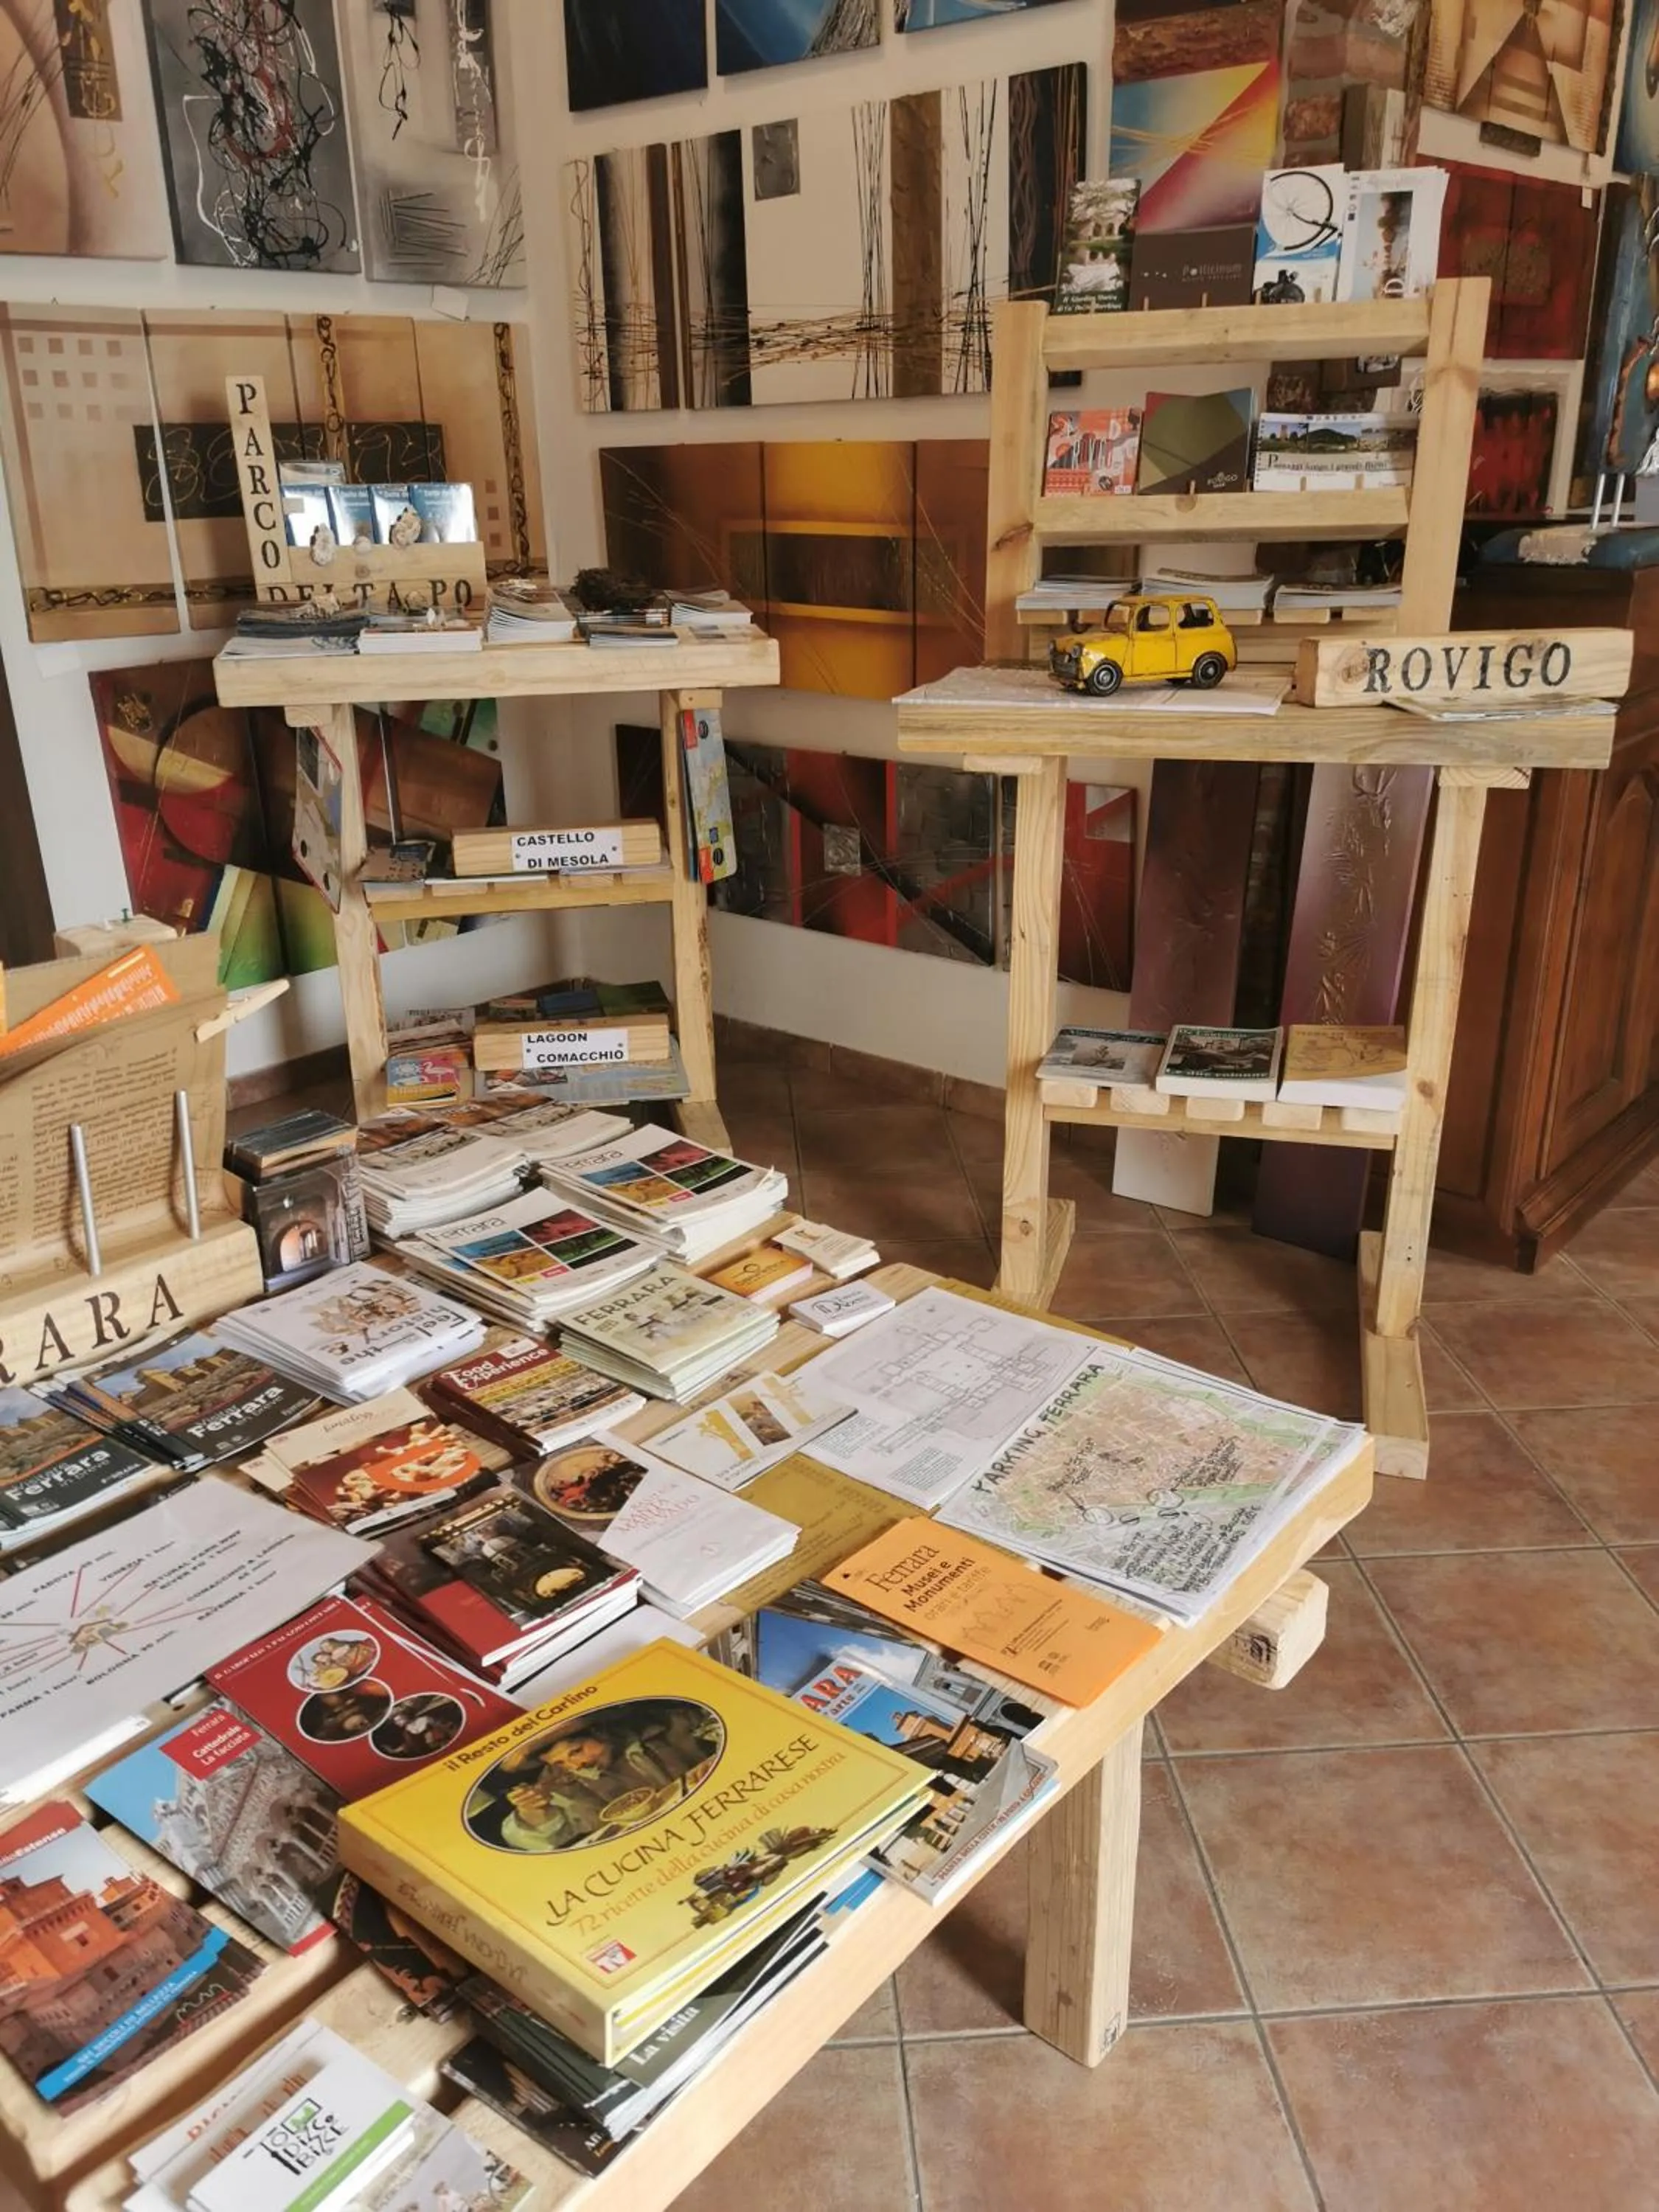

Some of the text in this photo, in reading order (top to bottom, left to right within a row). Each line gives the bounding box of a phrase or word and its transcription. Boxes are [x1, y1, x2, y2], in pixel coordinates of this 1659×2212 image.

[236, 383, 281, 569] PARCO
[428, 579, 473, 607] PO
[1363, 641, 1572, 695] ROVIGO
[517, 832, 595, 847] CASTELLO
[527, 853, 609, 869] DI MESOLA
[526, 1032, 588, 1044] LAGOON
[536, 1049, 625, 1064] COMACCHIO
[574, 1276, 678, 1325] FERRARA
[445, 1360, 494, 1388] Food
[462, 1348, 549, 1390] Experience
[187, 1383, 284, 1439] Ferrara
[5, 1448, 111, 1501] Ferrara
[865, 1545, 940, 1593] Ferrara
[901, 1561, 951, 1596] Musei e
[903, 1557, 976, 1613] Monumenti
[86, 1654, 139, 1685] BOLOGNA
[444, 1686, 598, 1773] il Resto del Carlino
[546, 1733, 819, 1927] LA CUCINA FERRARESE
[568, 1751, 846, 1936] 72 ricette della cucina di casa nostra
[629, 2006, 700, 2065] La visita
